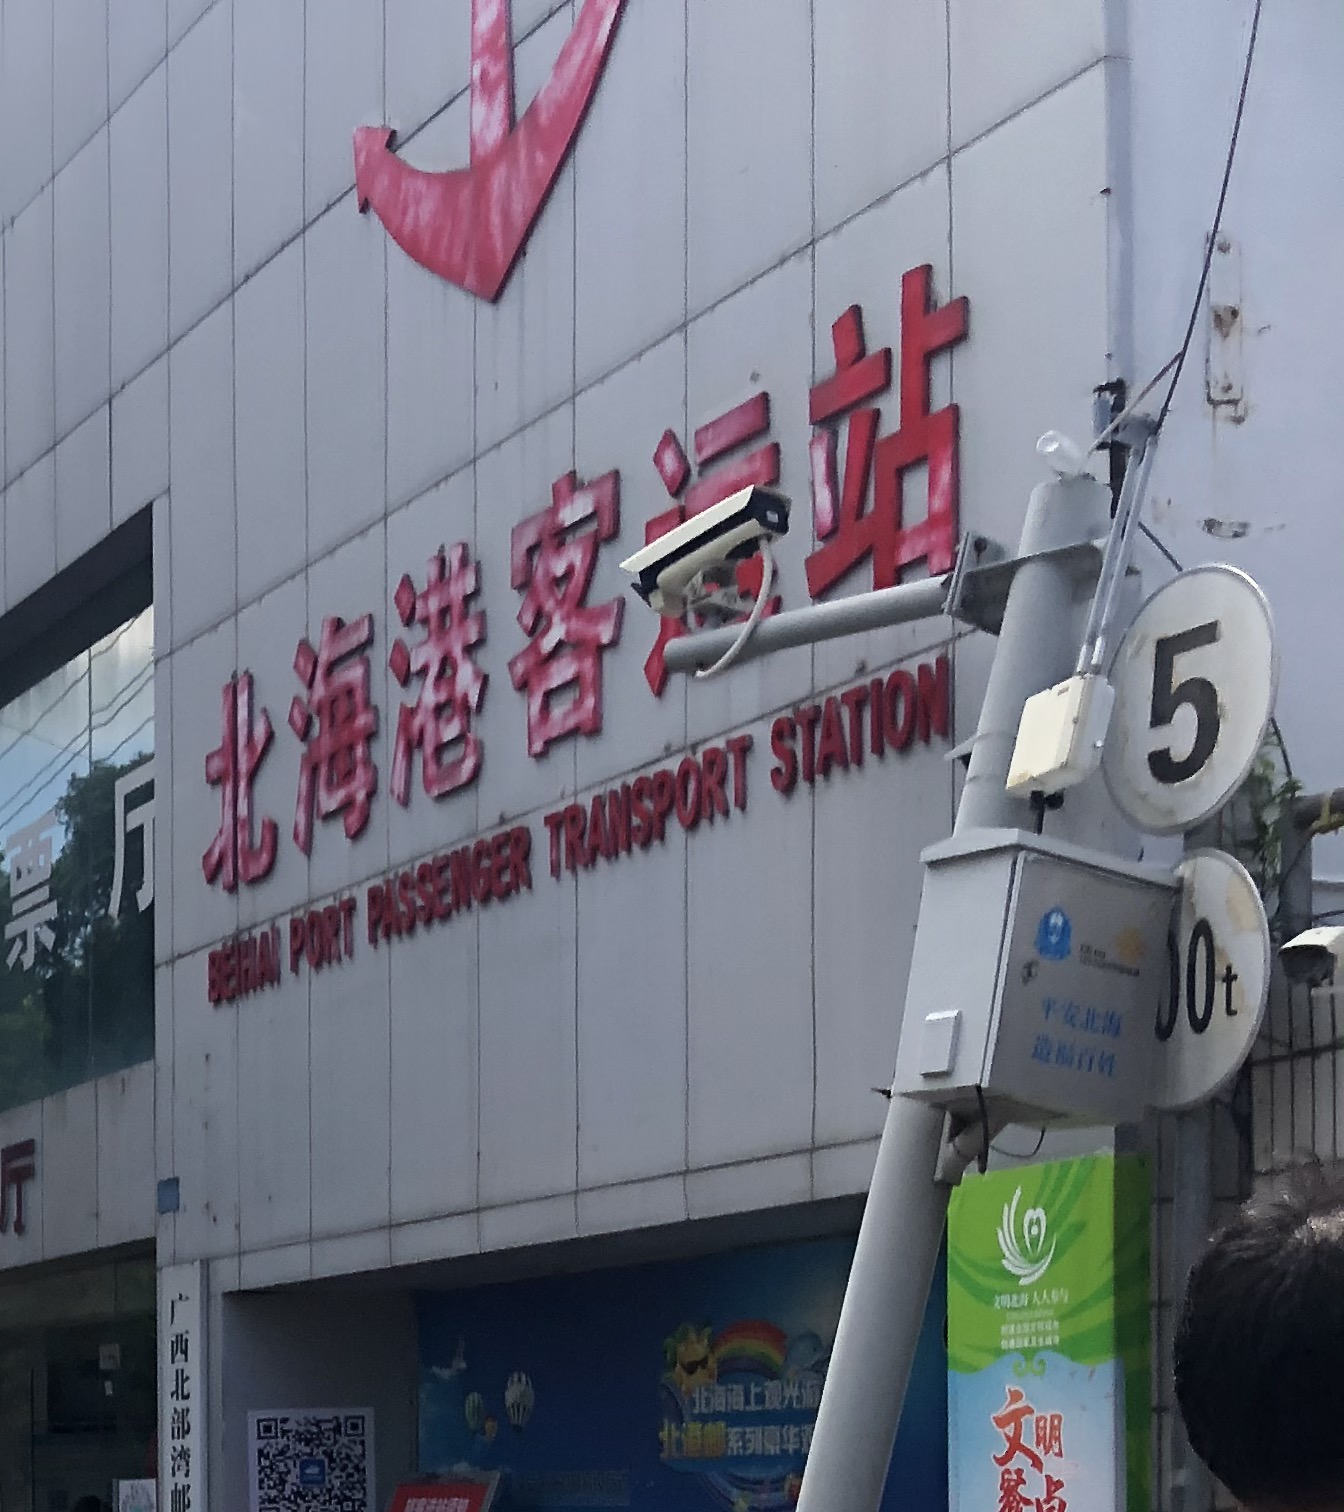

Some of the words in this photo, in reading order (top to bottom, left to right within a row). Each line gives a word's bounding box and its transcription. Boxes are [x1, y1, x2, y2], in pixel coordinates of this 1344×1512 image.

[202, 263, 970, 893] 北海港客运站
[1145, 620, 1221, 785] 5
[207, 928, 282, 1005] BEIHAI
[289, 895, 355, 977] PORT
[367, 826, 533, 947] PASSENGER
[544, 736, 754, 880] TRANSPORT
[769, 656, 951, 795] STATION
[991, 1386, 1064, 1474] 文明
